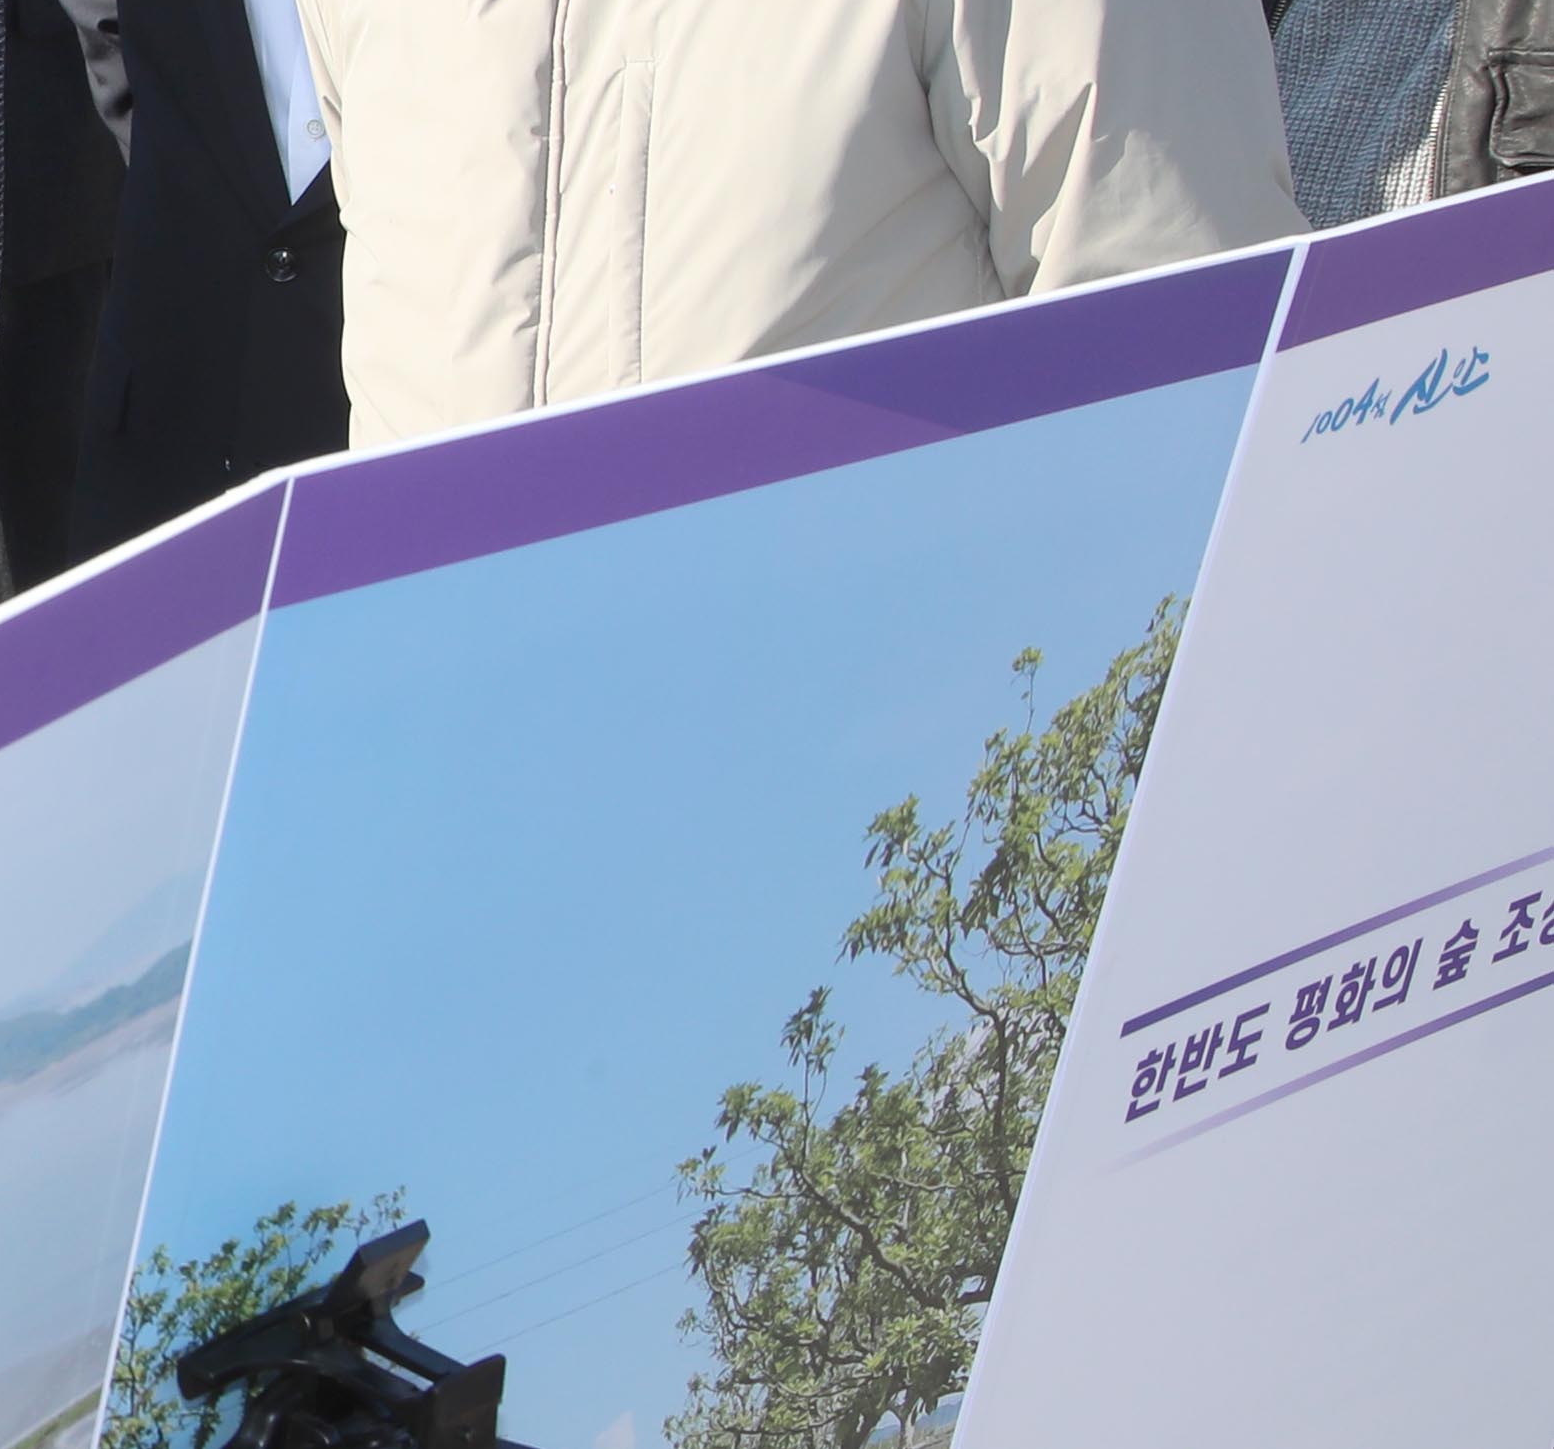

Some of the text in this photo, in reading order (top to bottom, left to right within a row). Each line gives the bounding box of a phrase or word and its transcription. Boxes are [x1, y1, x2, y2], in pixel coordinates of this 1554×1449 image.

[1124, 890, 1554, 1124] 한반도 평화의 숲 조
